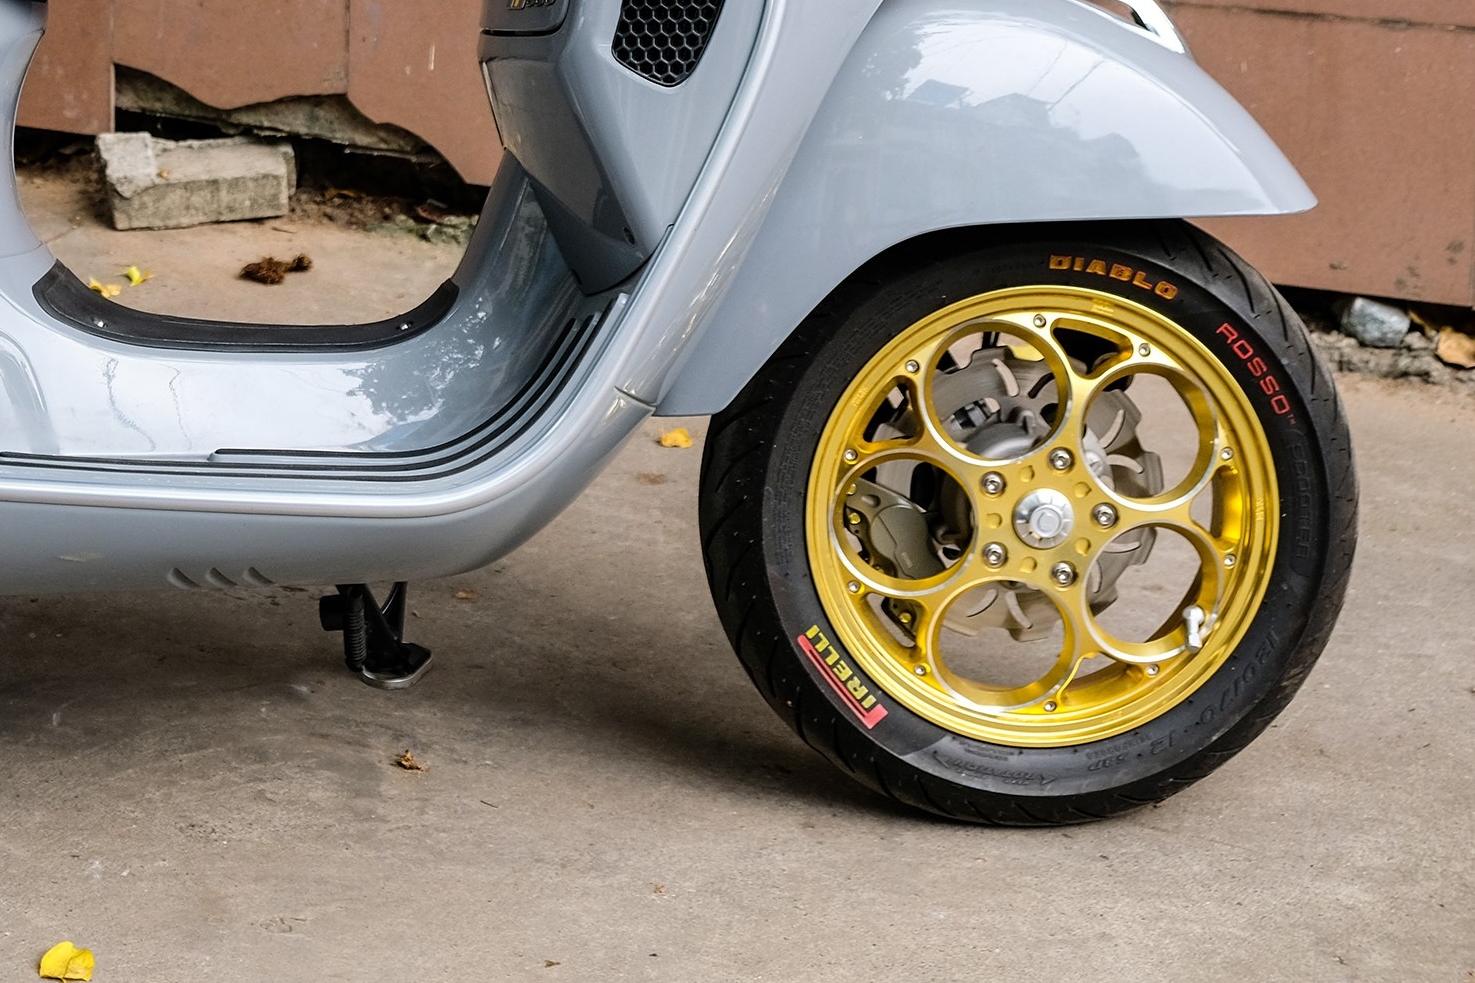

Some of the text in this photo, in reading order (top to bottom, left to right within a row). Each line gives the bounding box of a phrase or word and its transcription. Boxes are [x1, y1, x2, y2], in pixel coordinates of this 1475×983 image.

[1049, 254, 1179, 301] DIABLO
[1215, 322, 1291, 415] ROSSO
[797, 624, 888, 730] PIRELLI
